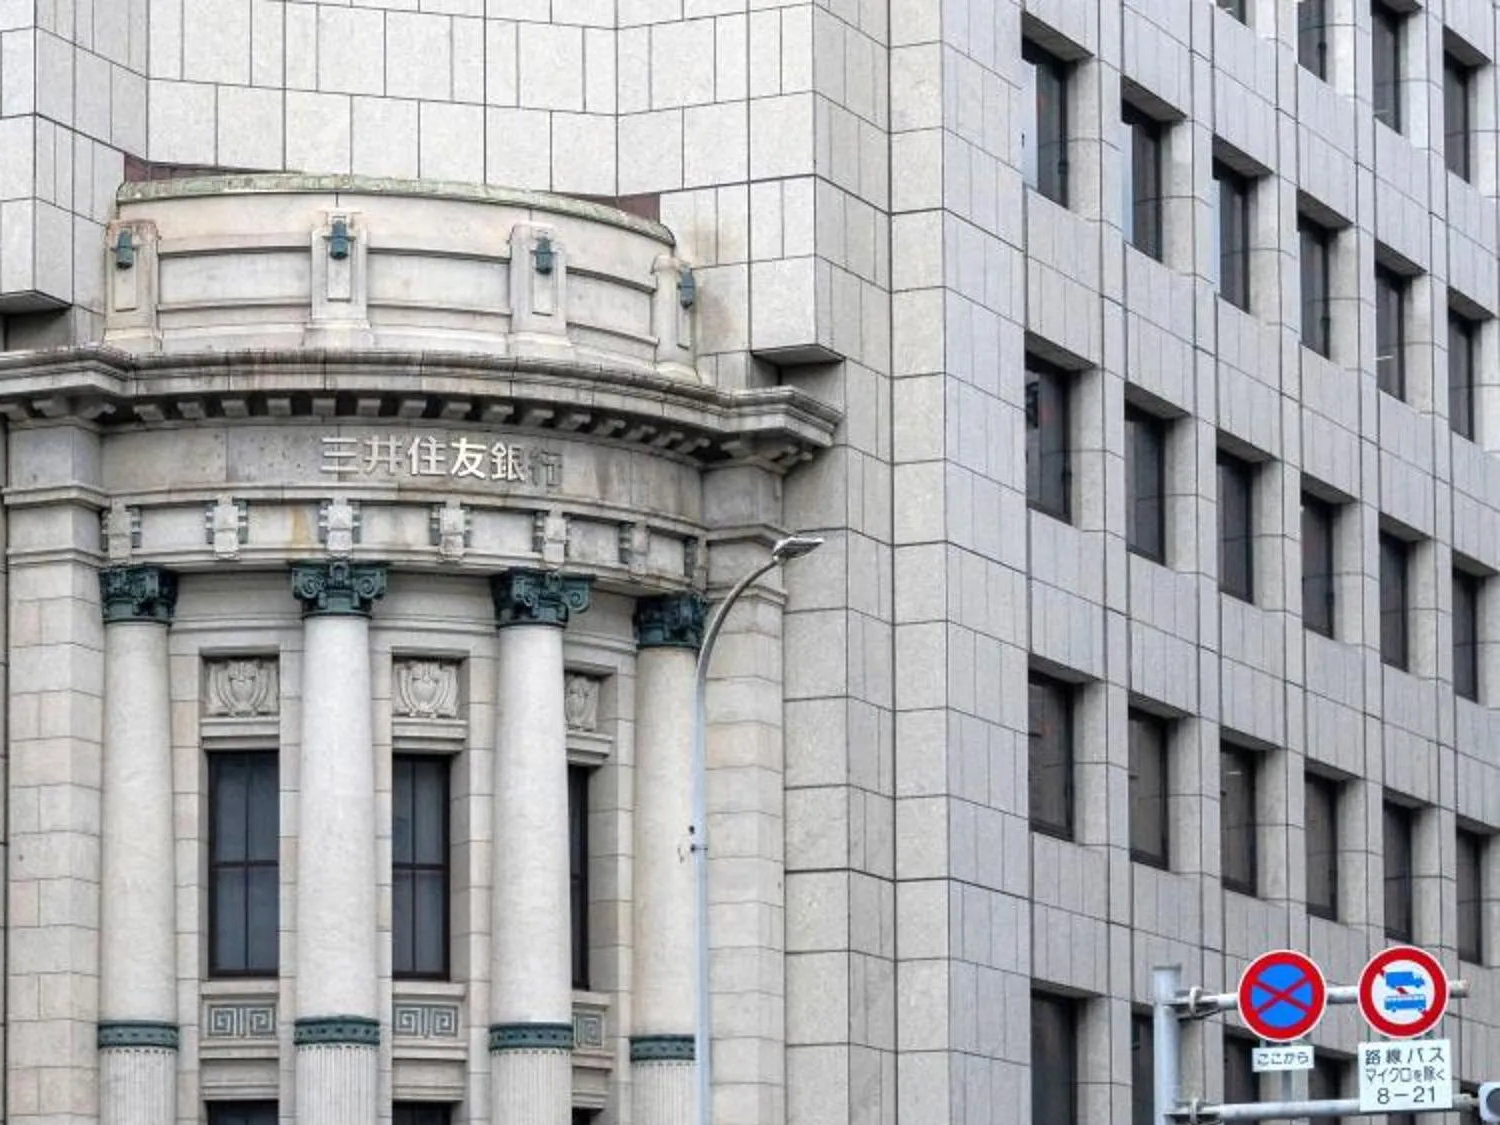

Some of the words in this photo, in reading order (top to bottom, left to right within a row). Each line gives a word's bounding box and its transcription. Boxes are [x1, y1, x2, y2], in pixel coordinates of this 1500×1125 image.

[320, 435, 563, 488] 三井住友銀行
[1257, 1051, 1309, 1066] ここから
[1365, 1047, 1445, 1065] 路線バス
